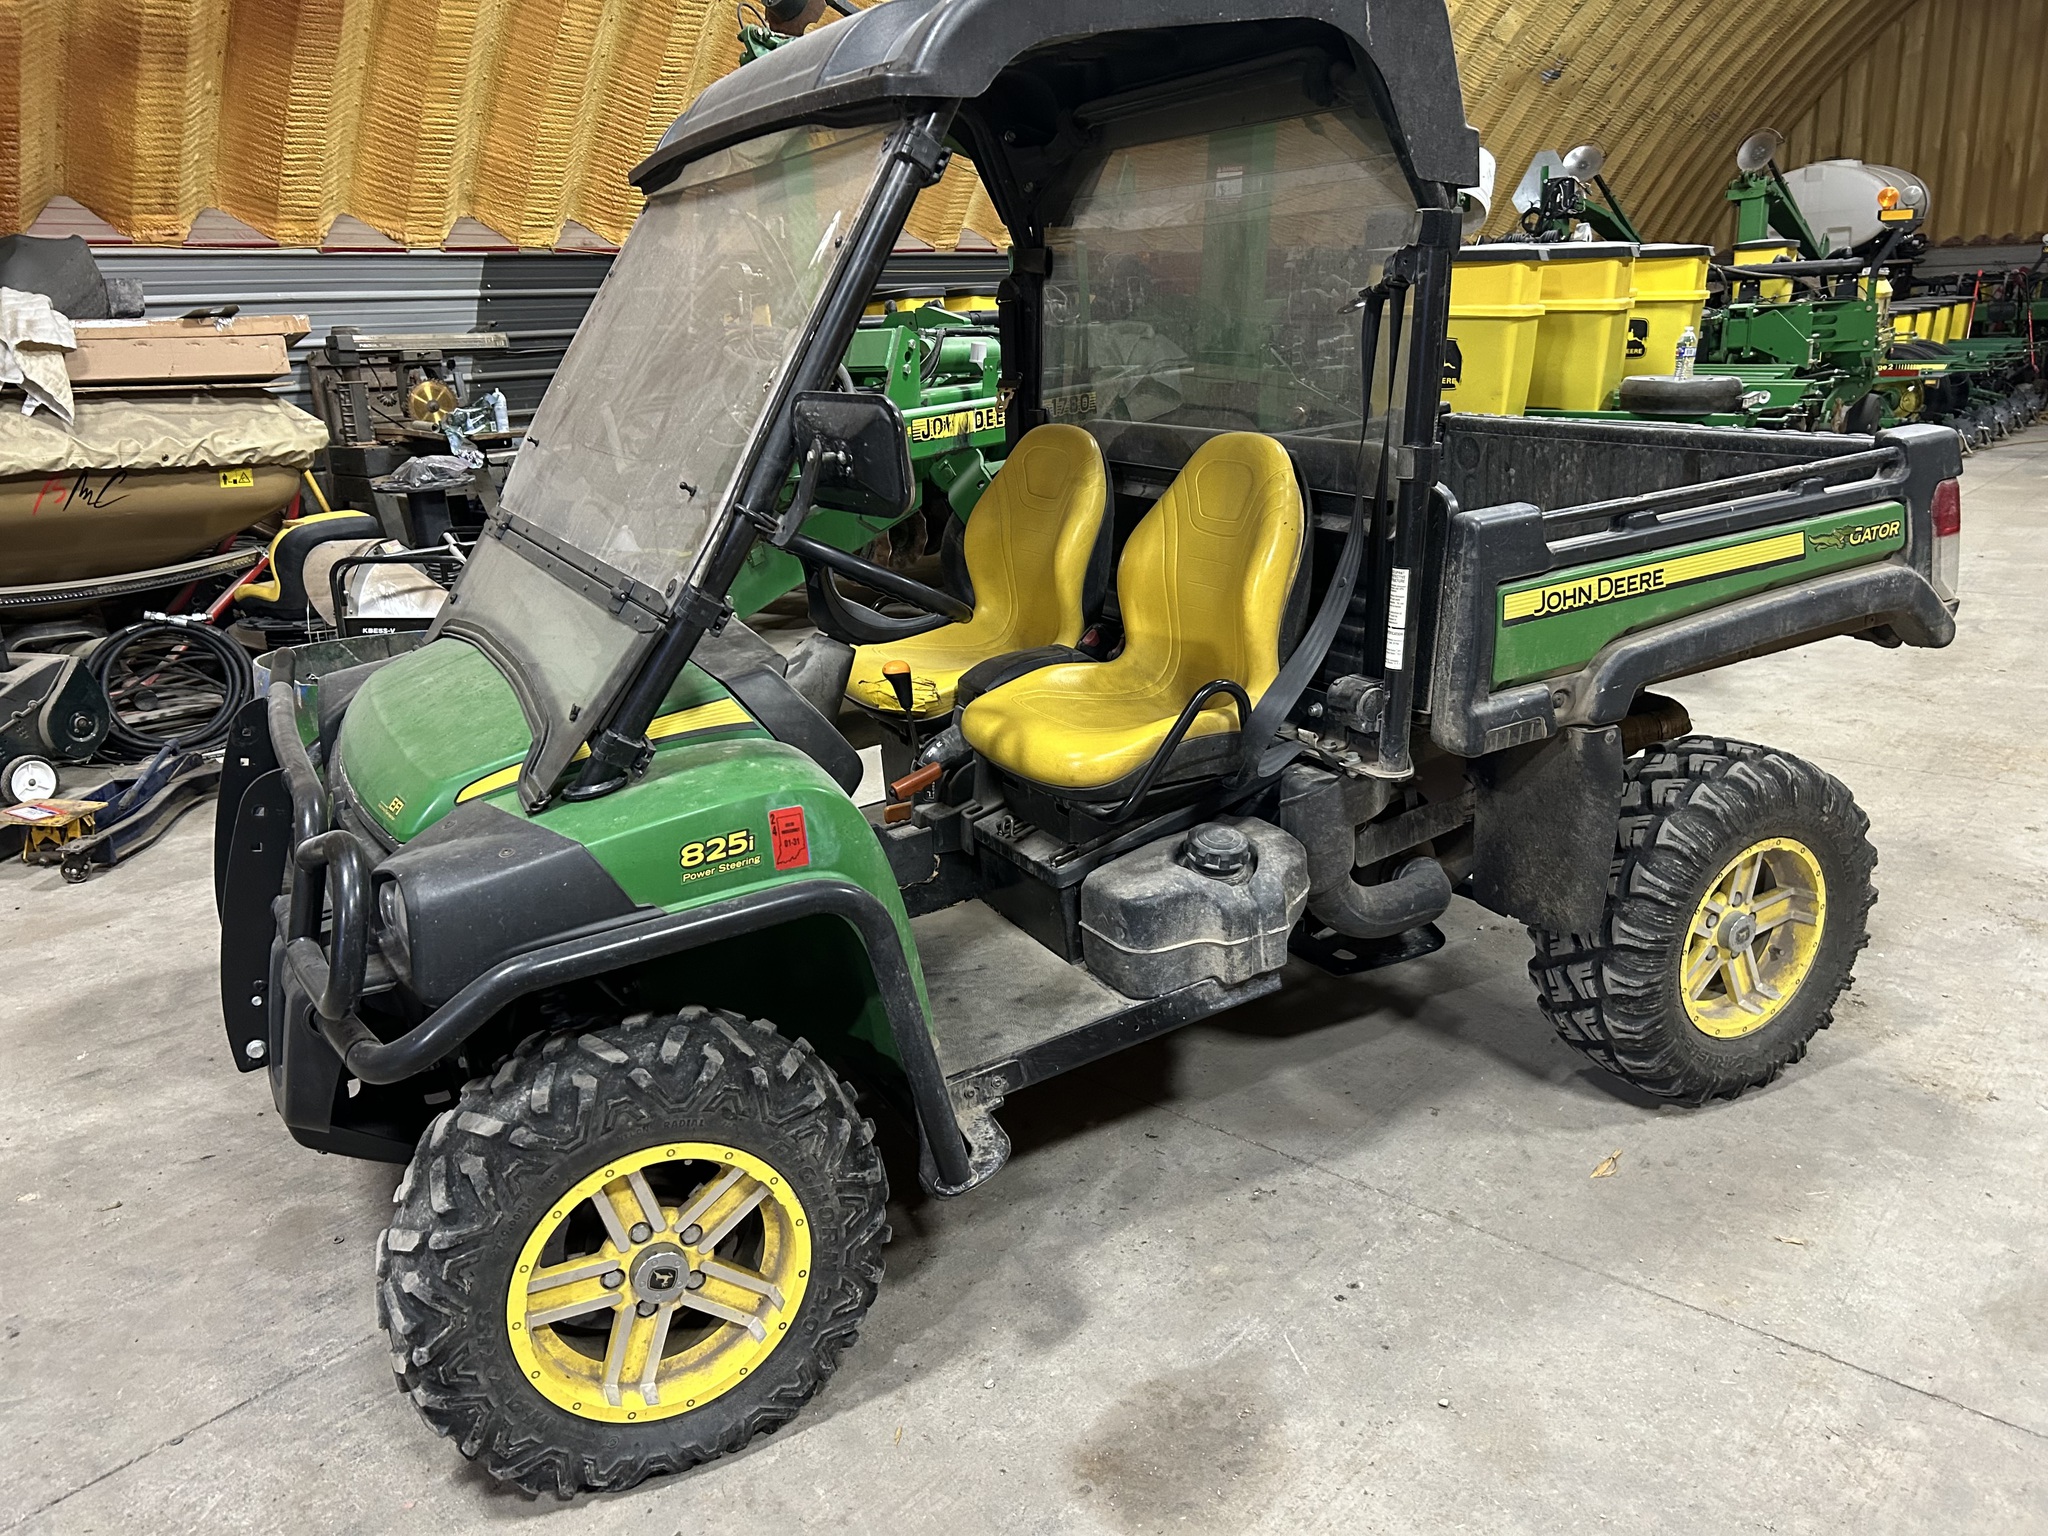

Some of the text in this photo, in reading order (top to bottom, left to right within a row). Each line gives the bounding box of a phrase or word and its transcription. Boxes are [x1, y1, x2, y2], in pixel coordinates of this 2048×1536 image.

[1849, 520, 1900, 545] GATOR
[1533, 568, 1665, 614] JOHN DEERE
[388, 796, 405, 816] EFI
[680, 830, 755, 868] 825i
[784, 838, 800, 848] 01-31
[682, 854, 761, 883] Power Steering
[663, 1118, 705, 1129] RADIAL
[537, 1173, 558, 1192] NHS
